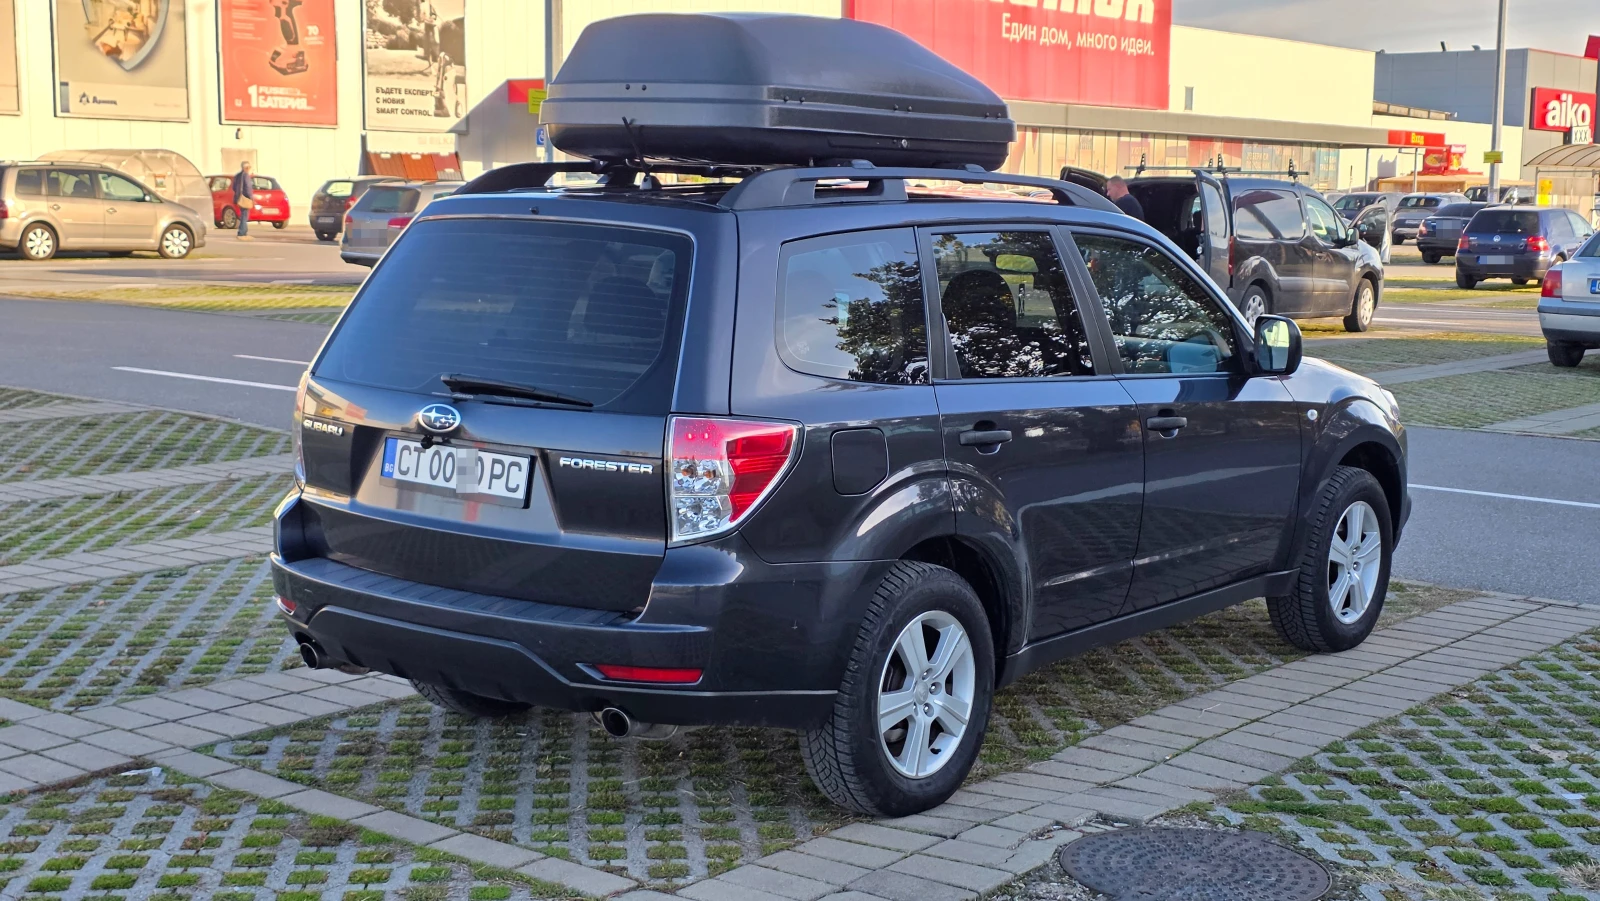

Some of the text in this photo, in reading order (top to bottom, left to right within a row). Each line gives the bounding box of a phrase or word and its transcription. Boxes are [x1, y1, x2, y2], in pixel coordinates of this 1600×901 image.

[1002, 12, 1037, 42] Един
[1040, 26, 1072, 50] дом,
[1076, 32, 1117, 51] много
[1120, 36, 1155, 56] идеи.
[248, 84, 258, 108] 1
[375, 86, 402, 95] БЪДЕТЕ
[382, 97, 405, 105] НОВИЯ
[1545, 93, 1591, 127] aiko
[375, 107, 399, 115] SMART
[303, 419, 343, 437] SUBARU
[384, 462, 394, 473] BG
[397, 444, 427, 478] CT
[488, 458, 523, 493] PC
[560, 456, 654, 475] FORESTER
